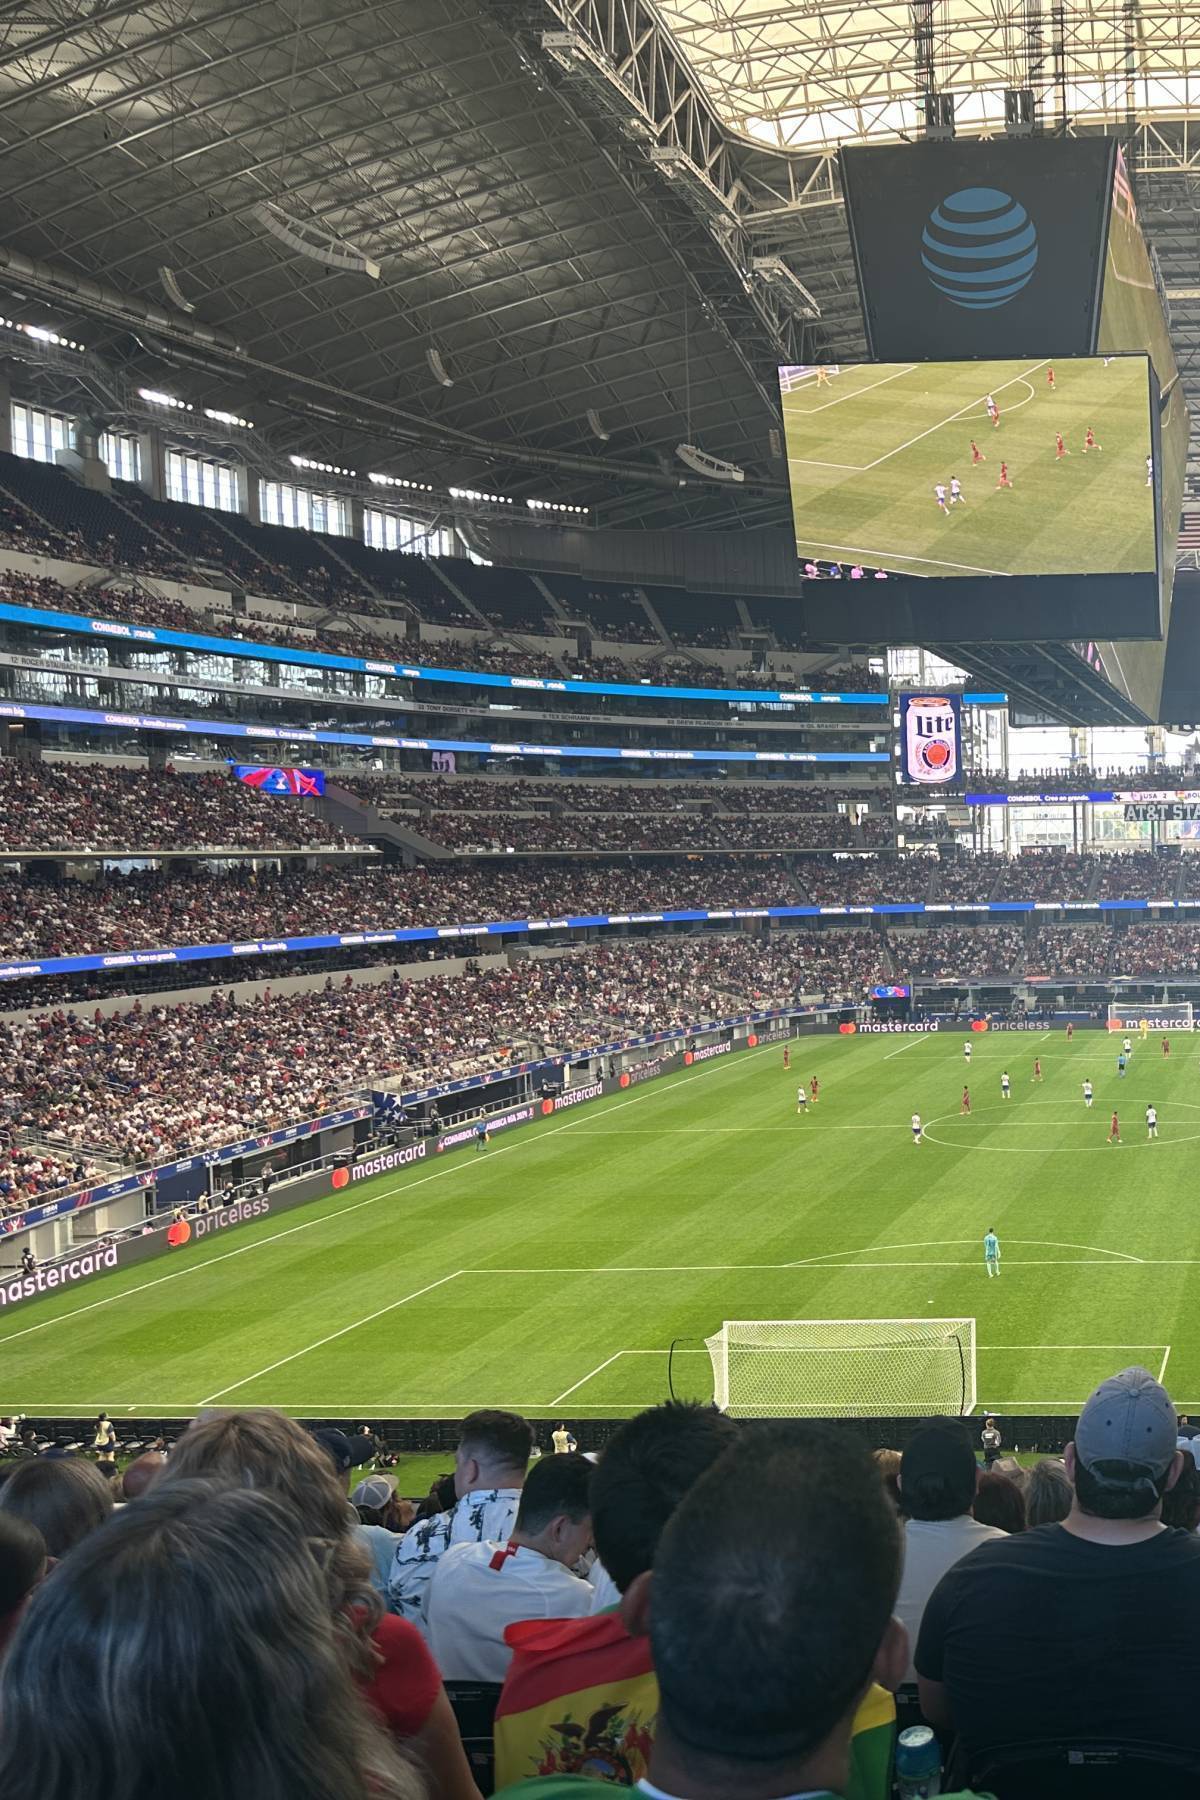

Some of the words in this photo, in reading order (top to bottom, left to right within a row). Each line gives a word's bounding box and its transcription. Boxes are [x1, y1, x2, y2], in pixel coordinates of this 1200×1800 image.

[92, 622, 131, 636] CONMEBOL
[916, 715, 952, 738] Lite
[1007, 794, 1043, 803] CONMEBOL
[1044, 793, 1059, 801] Cree
[1143, 792, 1158, 800] USA
[1187, 791, 1200, 799] BOL
[1126, 803, 1170, 820] AT&T
[859, 1020, 939, 1032] mastercard
[991, 1020, 1050, 1033] priceless
[759, 1029, 791, 1045] priceless
[694, 1041, 731, 1061] mastercard
[631, 1066, 661, 1083] priceless
[555, 1081, 603, 1109] mastercard
[444, 1127, 475, 1146] CONMEBOL
[352, 1141, 426, 1179] mastercard
[195, 1196, 270, 1239] priceless
